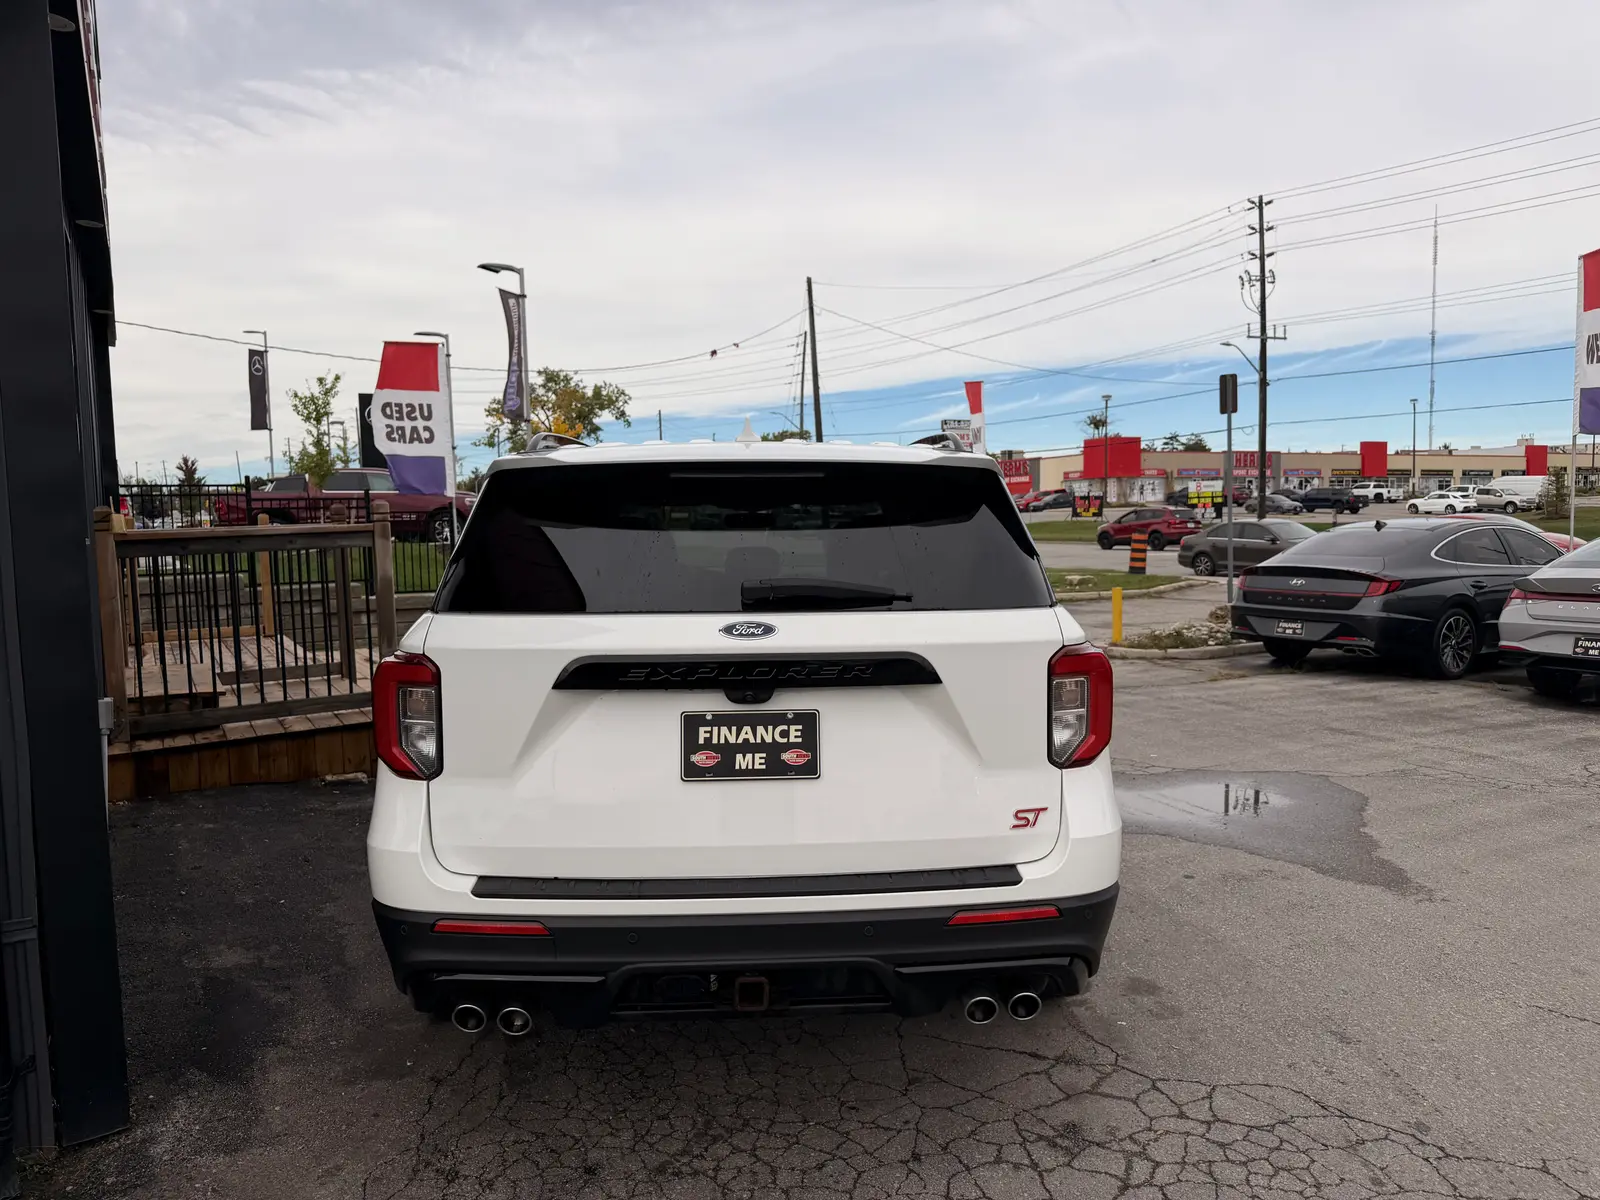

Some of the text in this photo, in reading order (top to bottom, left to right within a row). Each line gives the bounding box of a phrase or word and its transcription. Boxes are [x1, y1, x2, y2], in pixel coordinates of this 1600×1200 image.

[732, 623, 765, 635] Ford
[619, 665, 873, 681] EXPLORER
[698, 725, 803, 744] FINANCE
[735, 753, 767, 770] ME
[1010, 806, 1049, 829] ST
